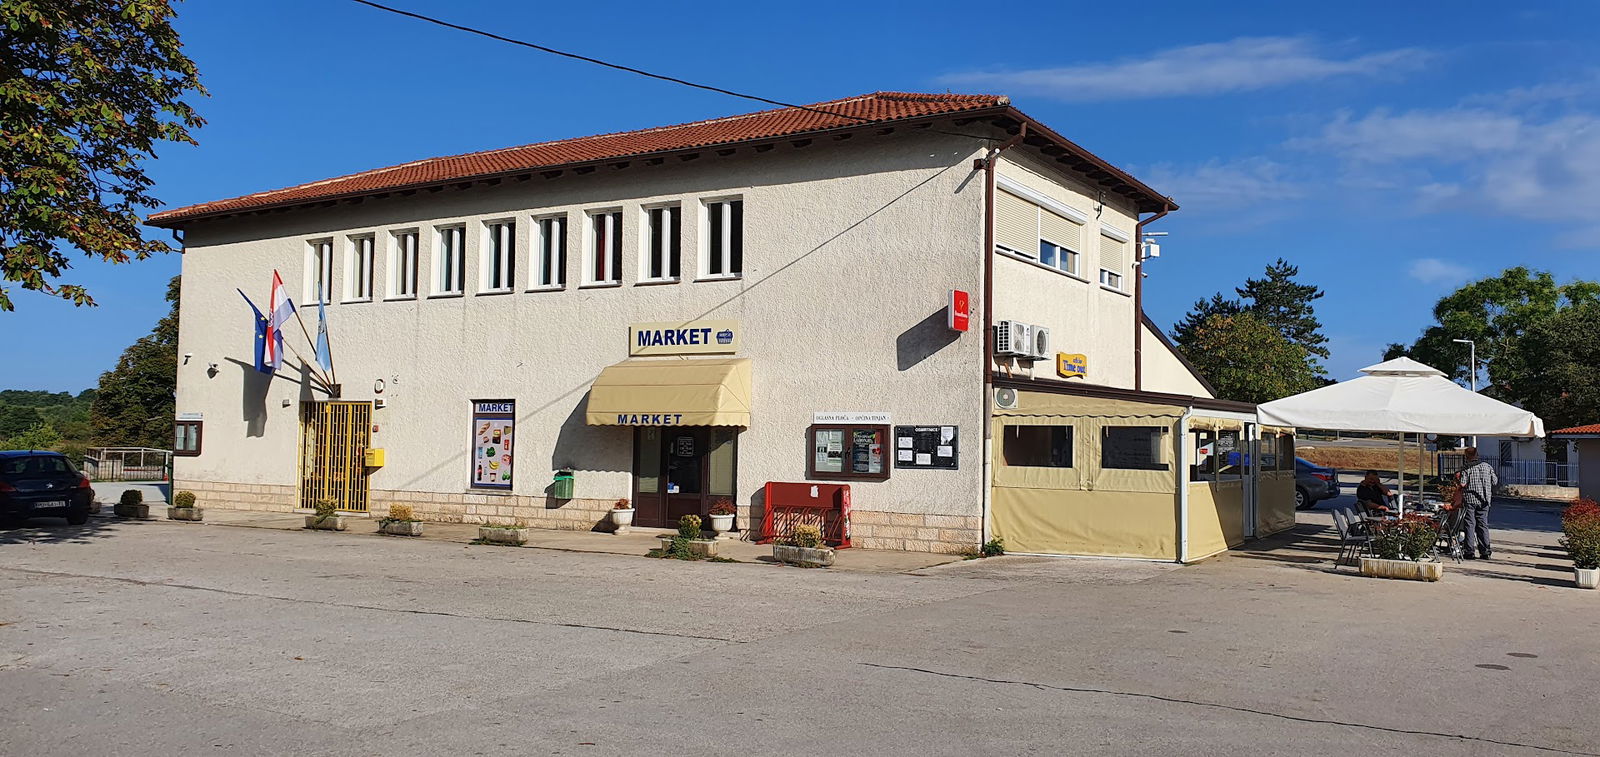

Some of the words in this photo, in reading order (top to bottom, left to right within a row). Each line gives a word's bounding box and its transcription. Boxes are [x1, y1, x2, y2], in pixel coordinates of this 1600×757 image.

[638, 328, 712, 346] MARKET
[479, 403, 513, 412] MARKET
[617, 414, 682, 424] MARKET
